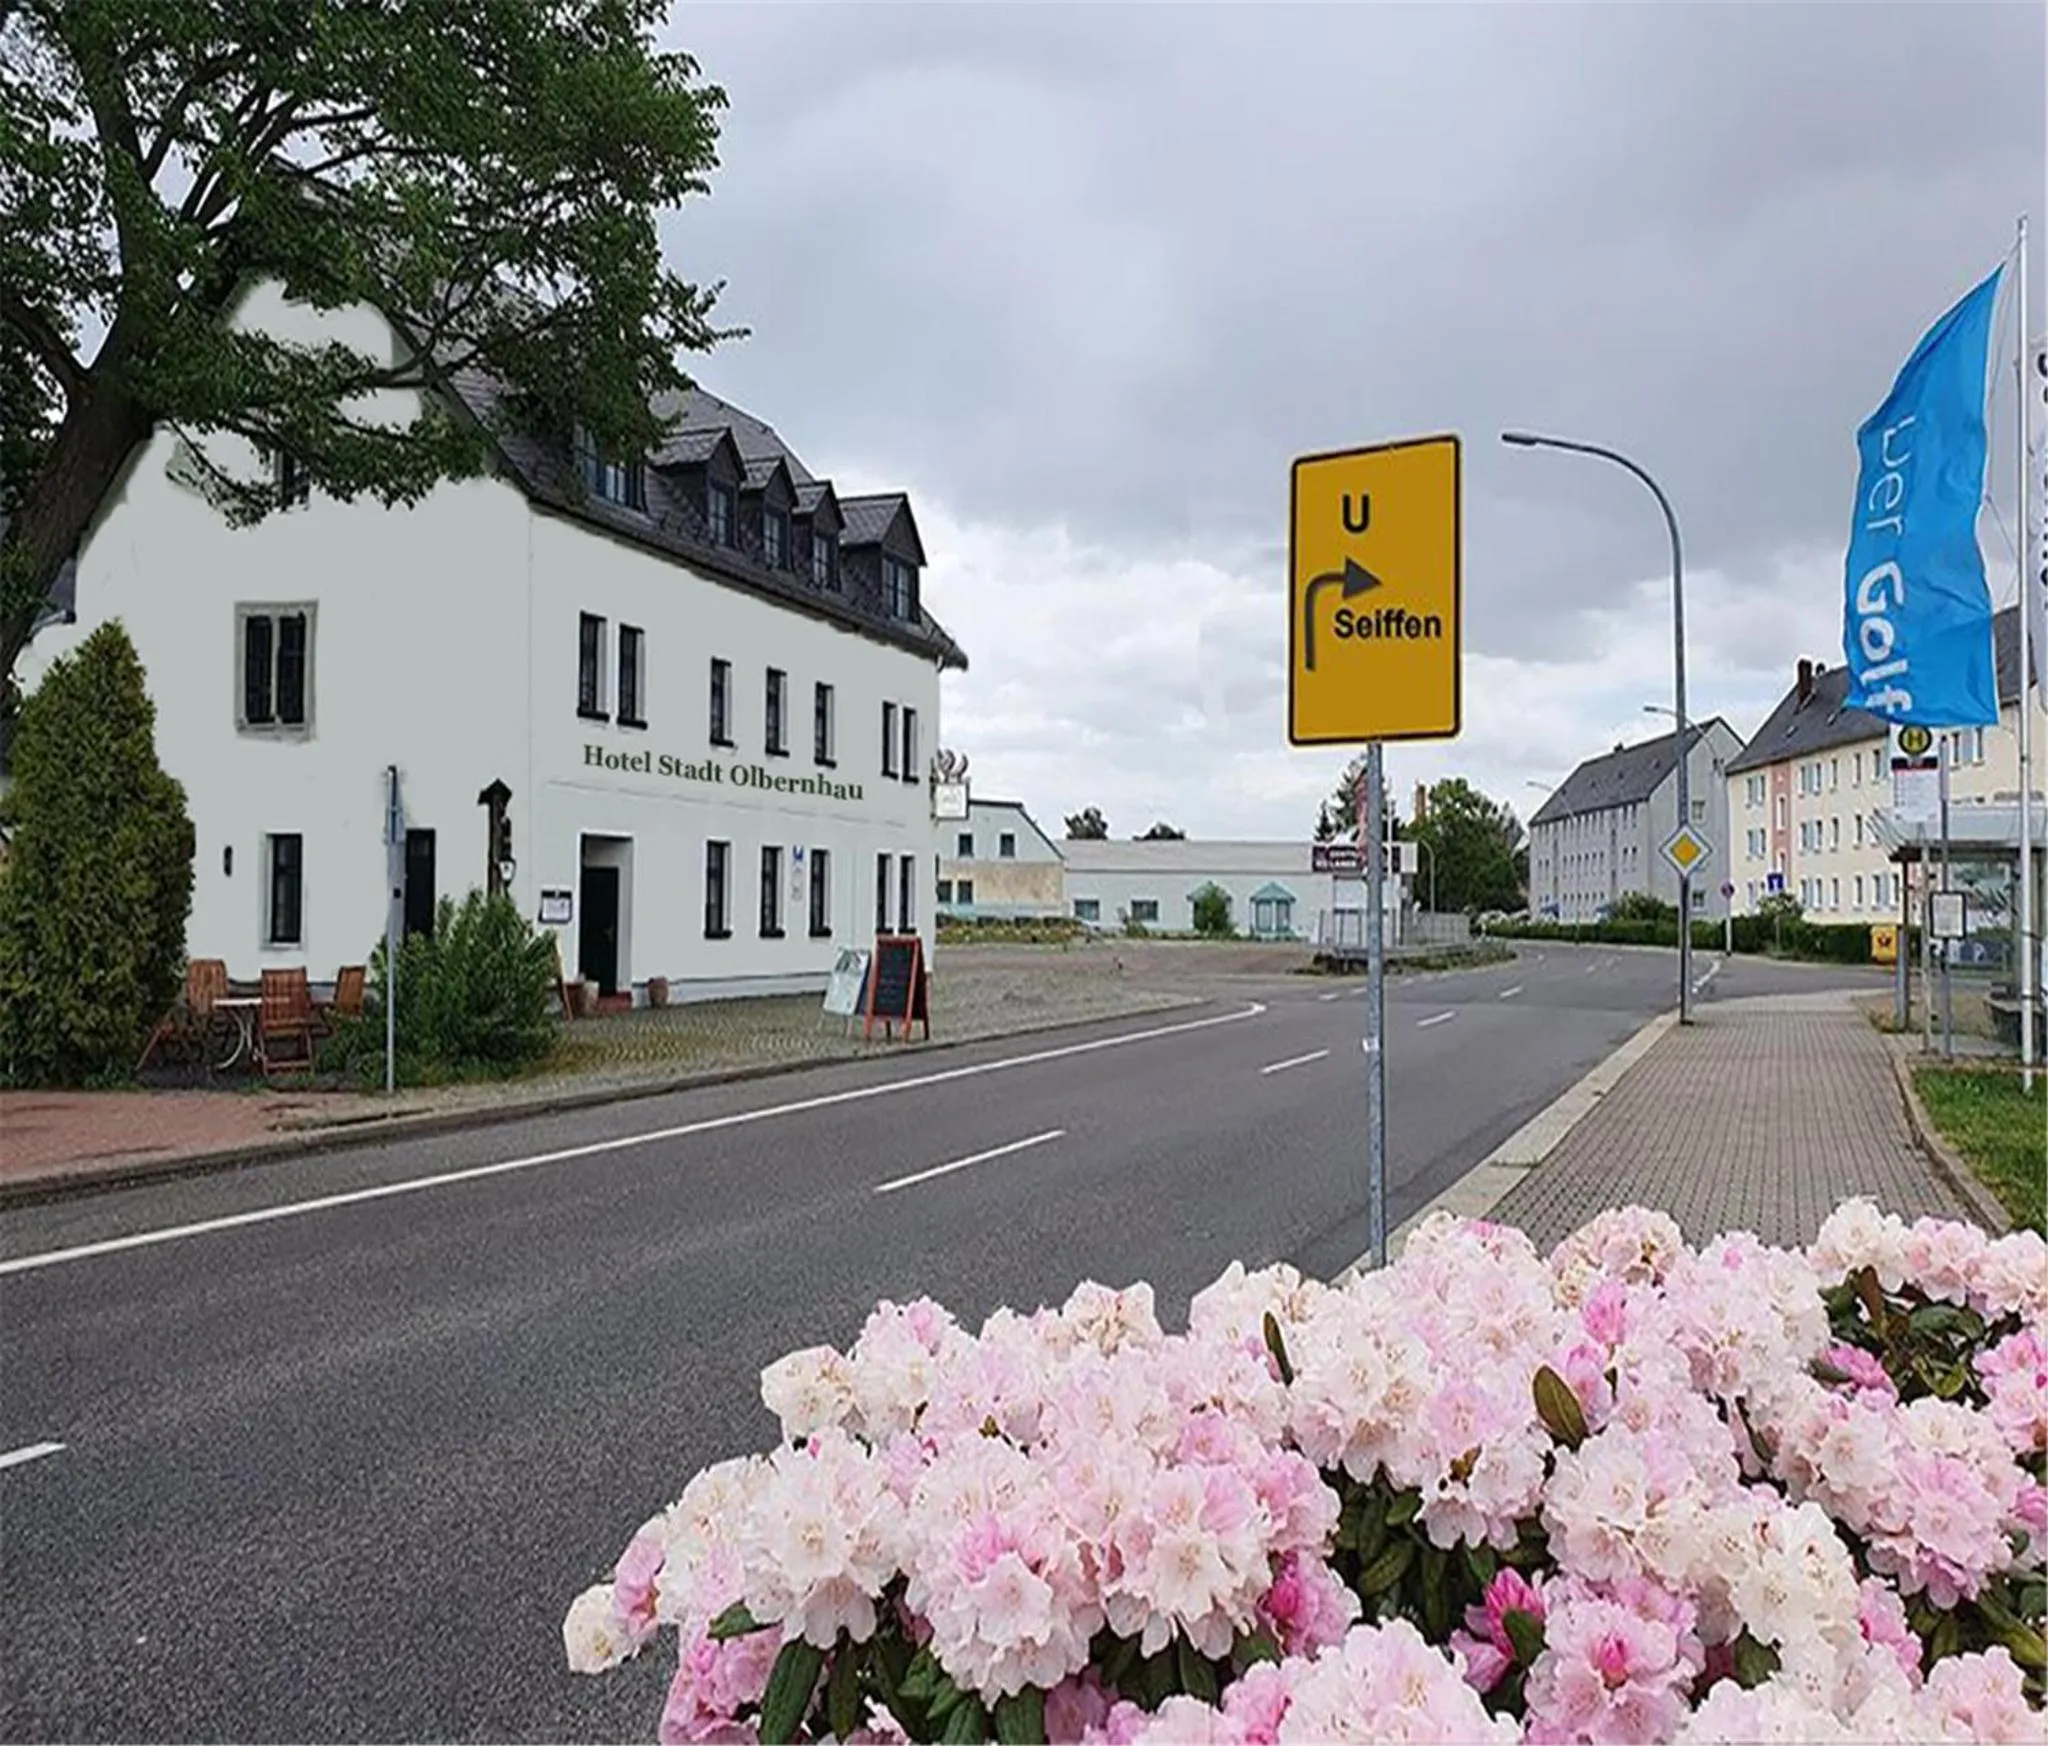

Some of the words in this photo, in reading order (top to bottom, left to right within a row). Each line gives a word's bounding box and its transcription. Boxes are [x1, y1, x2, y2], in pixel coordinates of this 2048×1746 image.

[1341, 493, 1371, 534] U
[1333, 607, 1442, 640] Seiffen
[1856, 560, 1913, 714] Golf
[1907, 727, 1923, 748] H
[583, 743, 652, 774] Hotel
[657, 753, 723, 784] Stadt
[729, 764, 864, 801] Olbernhau
